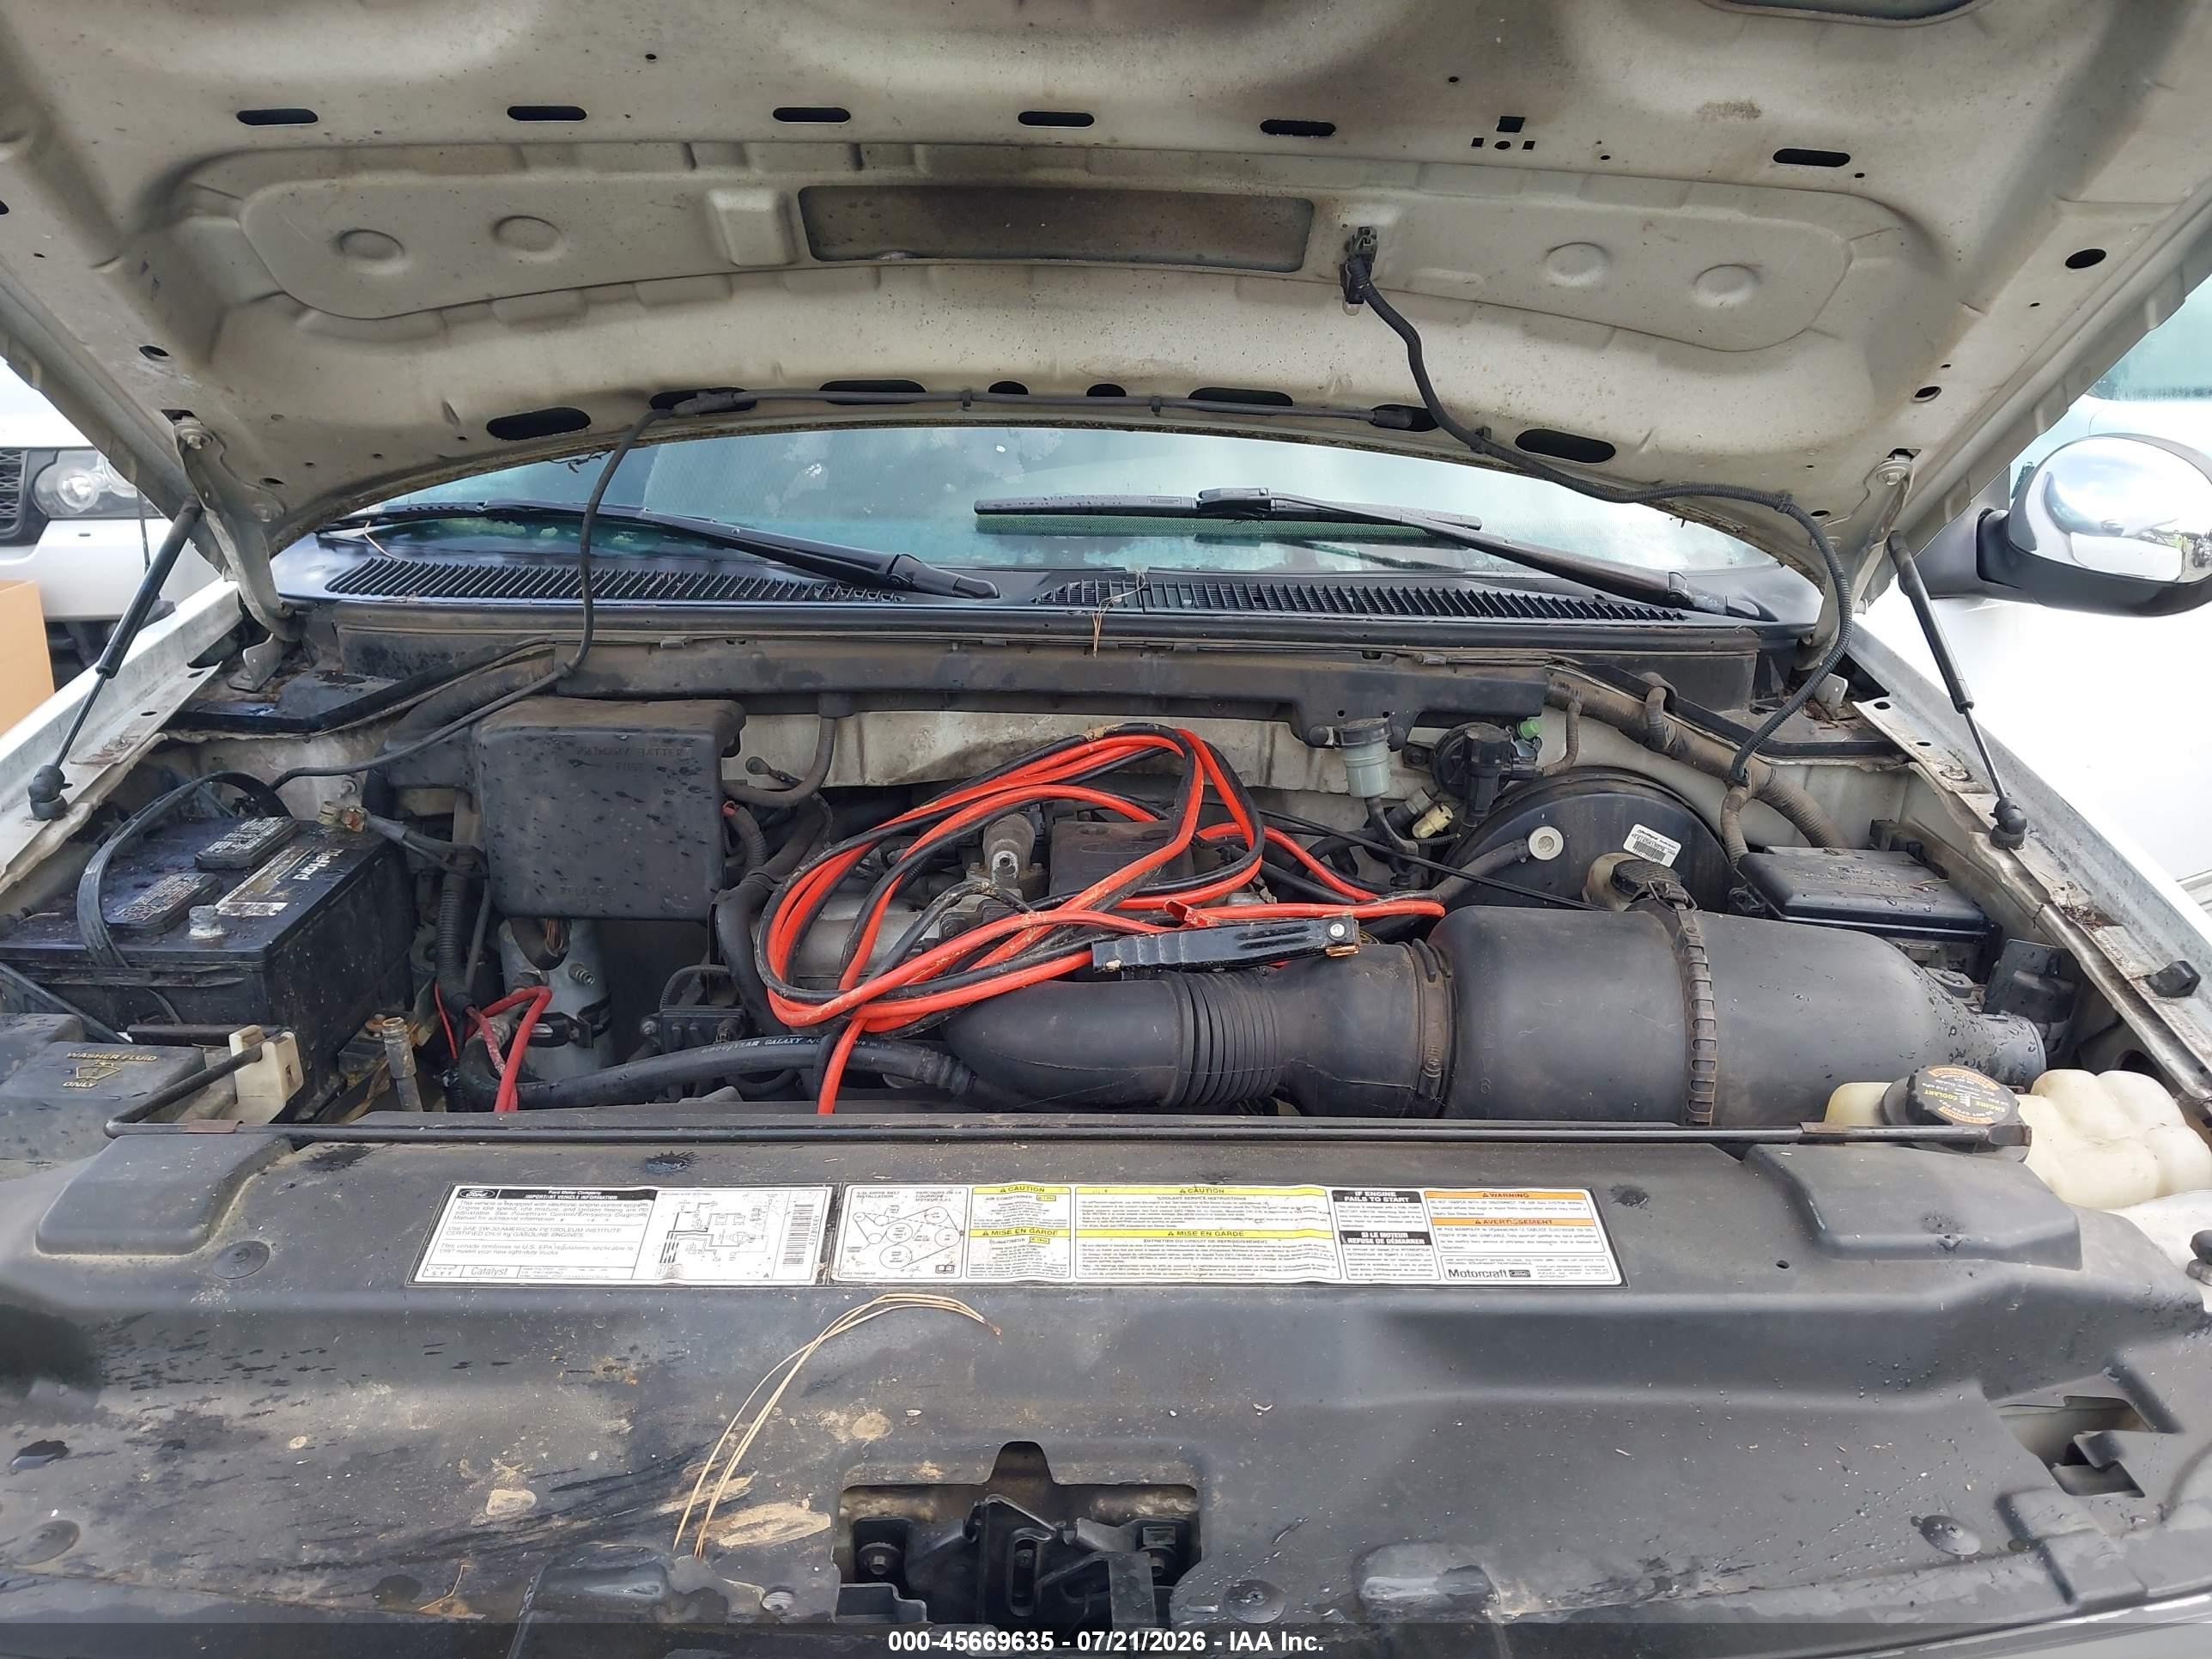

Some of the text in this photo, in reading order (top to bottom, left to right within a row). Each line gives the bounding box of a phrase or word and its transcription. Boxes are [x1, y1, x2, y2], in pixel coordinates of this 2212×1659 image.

[764, 1037, 803, 1046] GALAXY
[67, 1052, 120, 1061] WASHER
[1923, 1090, 1958, 1101] COOLANT
[471, 1267, 508, 1277] Catalyst
[1448, 1269, 1506, 1279] Motorcraft
